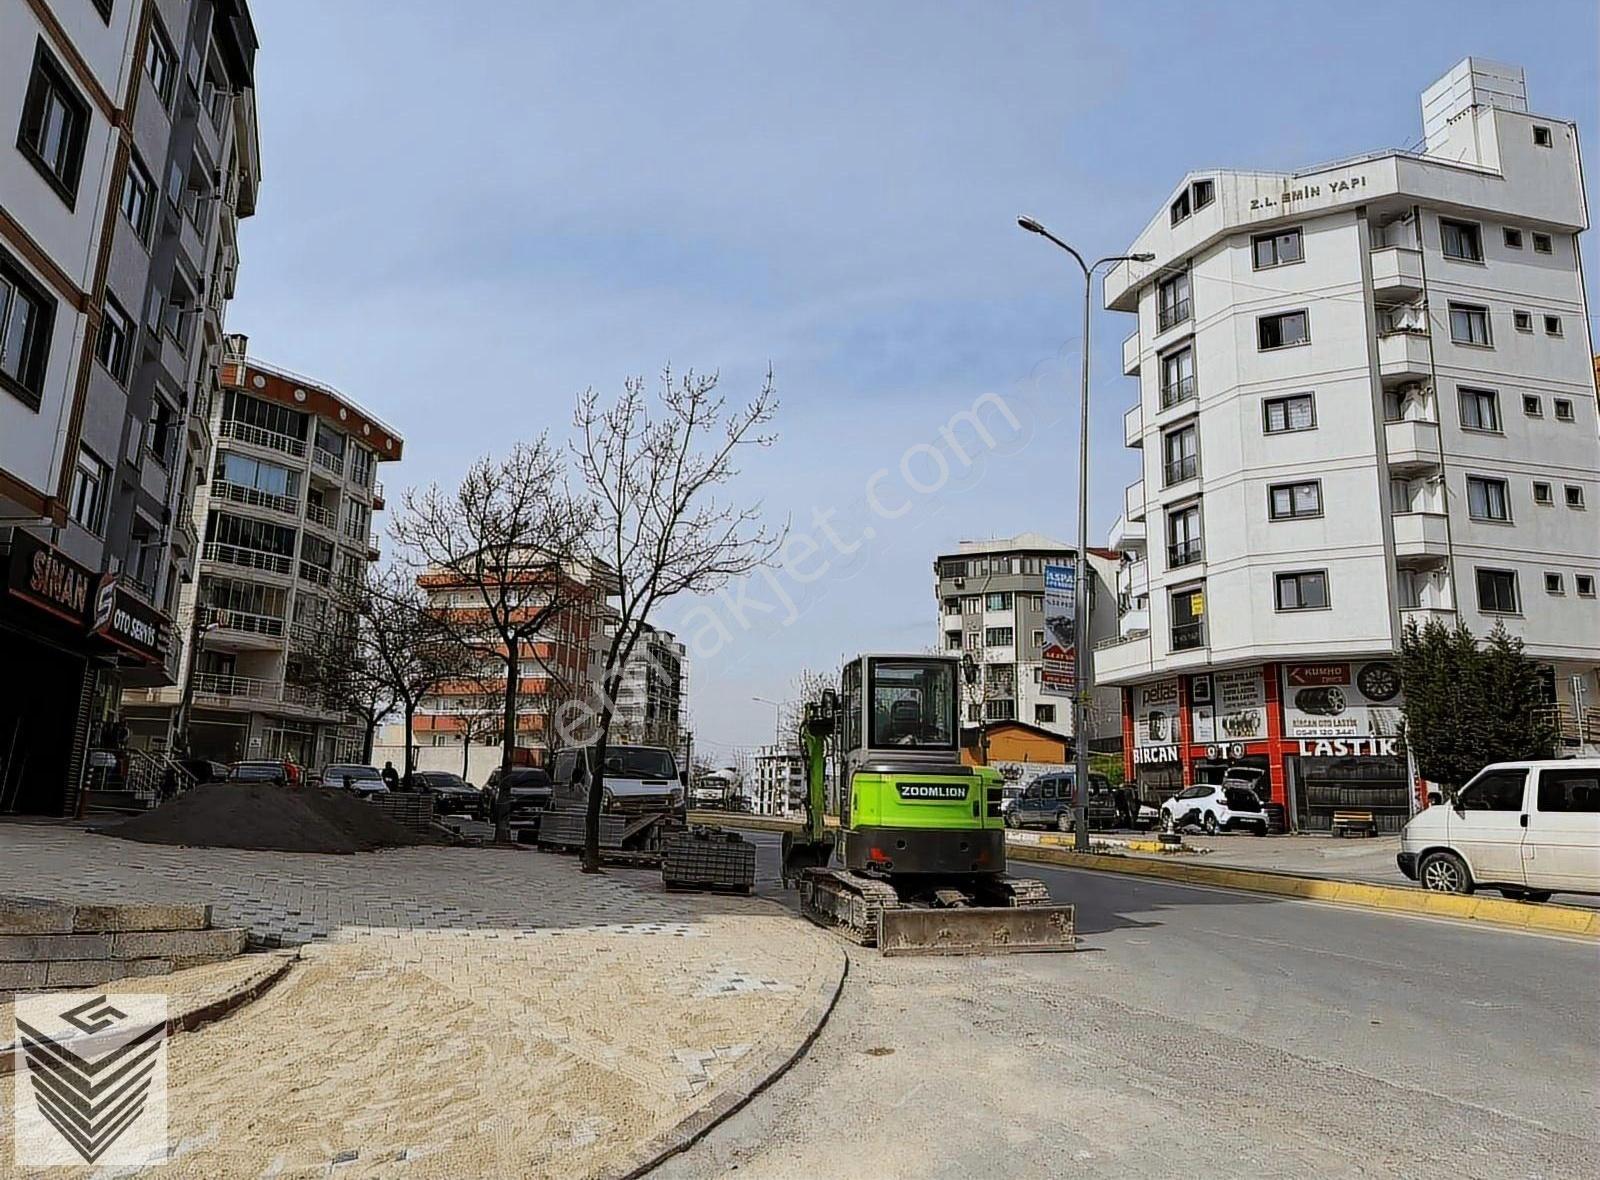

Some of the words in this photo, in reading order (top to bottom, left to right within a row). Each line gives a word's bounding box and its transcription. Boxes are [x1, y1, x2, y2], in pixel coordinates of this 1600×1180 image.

[1329, 176, 1366, 193] YAPI
[31, 550, 89, 613] SİNAN
[114, 609, 131, 634] OTO
[130, 618, 156, 646] SERVİS
[1305, 667, 1342, 677] KUMHO
[1133, 745, 1178, 764] BİRCAN
[1206, 742, 1245, 759] OTO
[1299, 734, 1398, 756] LASTİK
[901, 786, 966, 797] ZOOMLION
